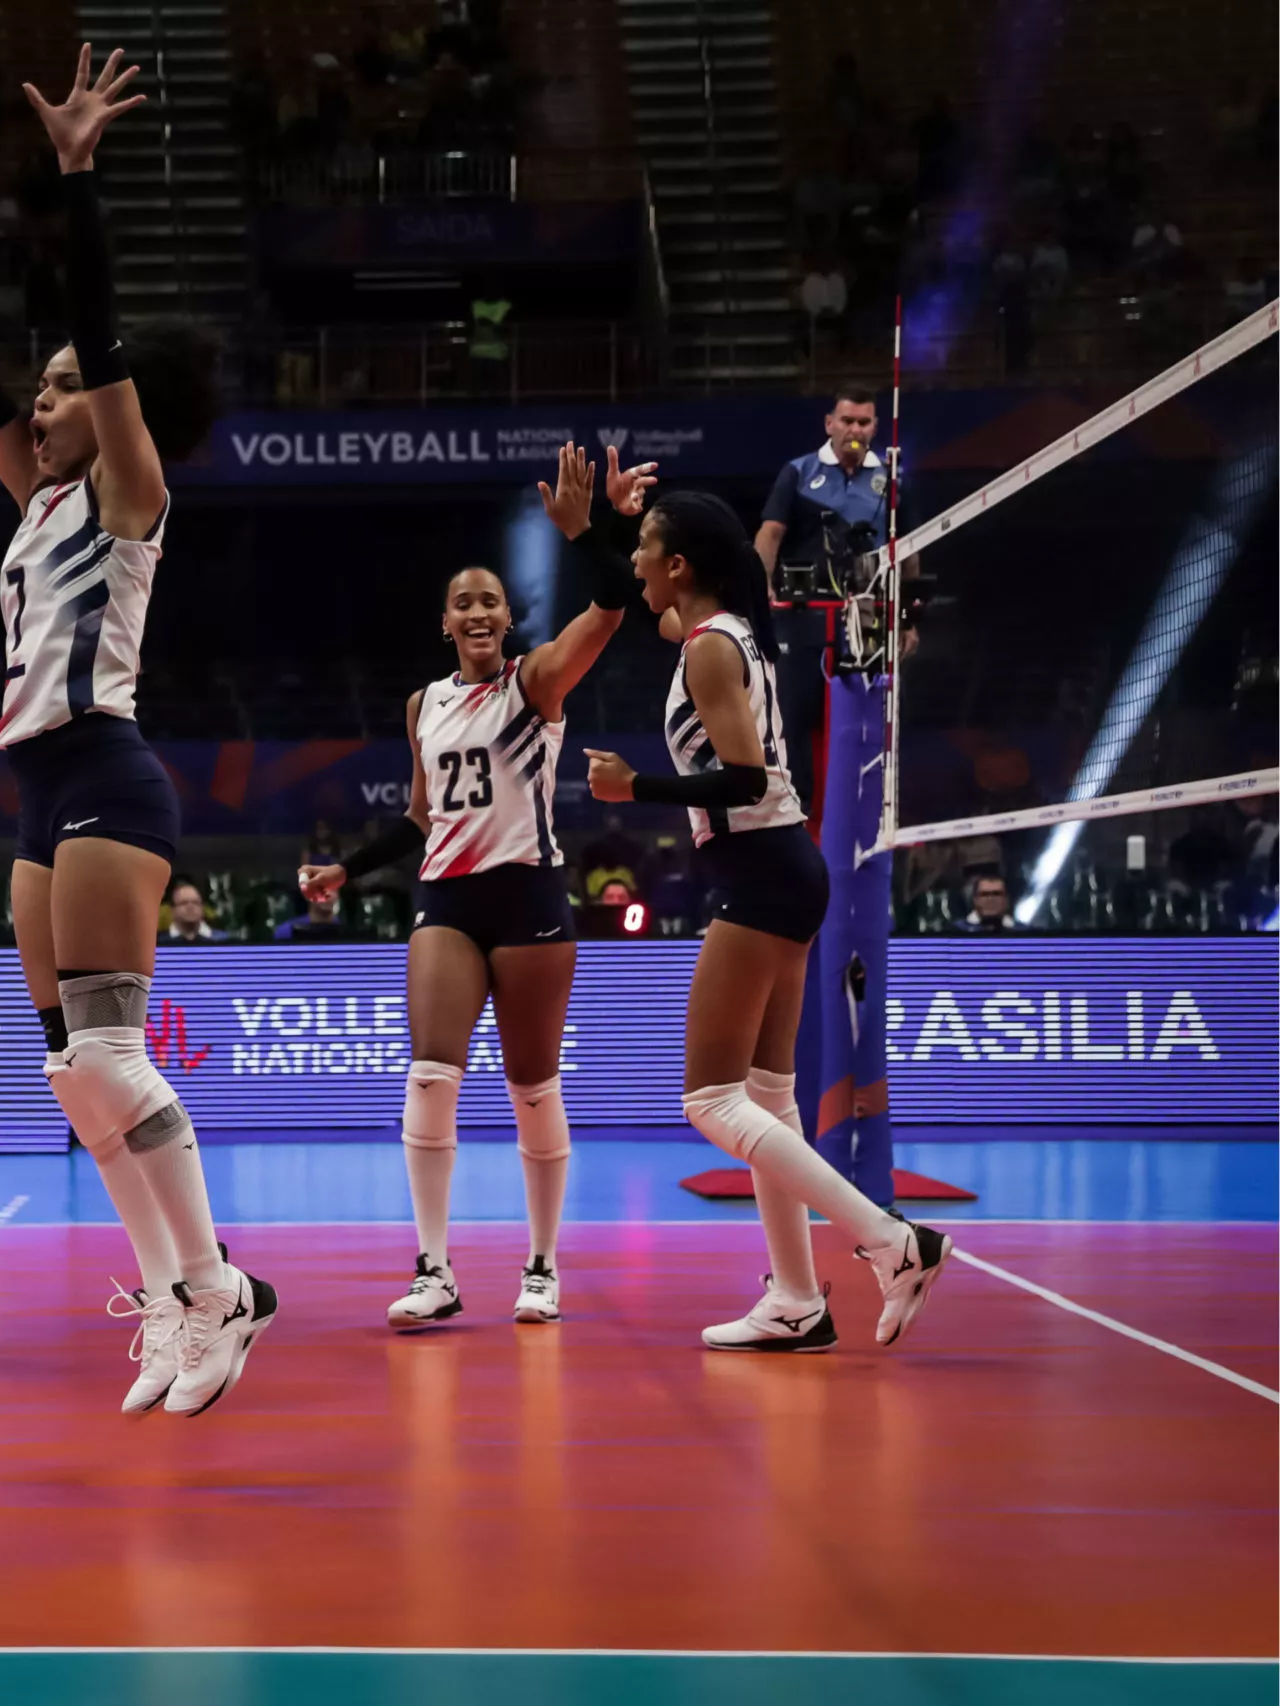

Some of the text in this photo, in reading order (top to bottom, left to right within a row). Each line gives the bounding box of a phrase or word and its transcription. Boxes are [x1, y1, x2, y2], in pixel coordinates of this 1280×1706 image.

[231, 429, 490, 466] VOLLEYBALL
[496, 428, 575, 444] NATIONS
[496, 445, 562, 462] LEAGU
[6, 566, 26, 653] 7
[439, 747, 493, 812] 23
[624, 903, 645, 932] 0
[232, 1042, 406, 1074] NATIONS
